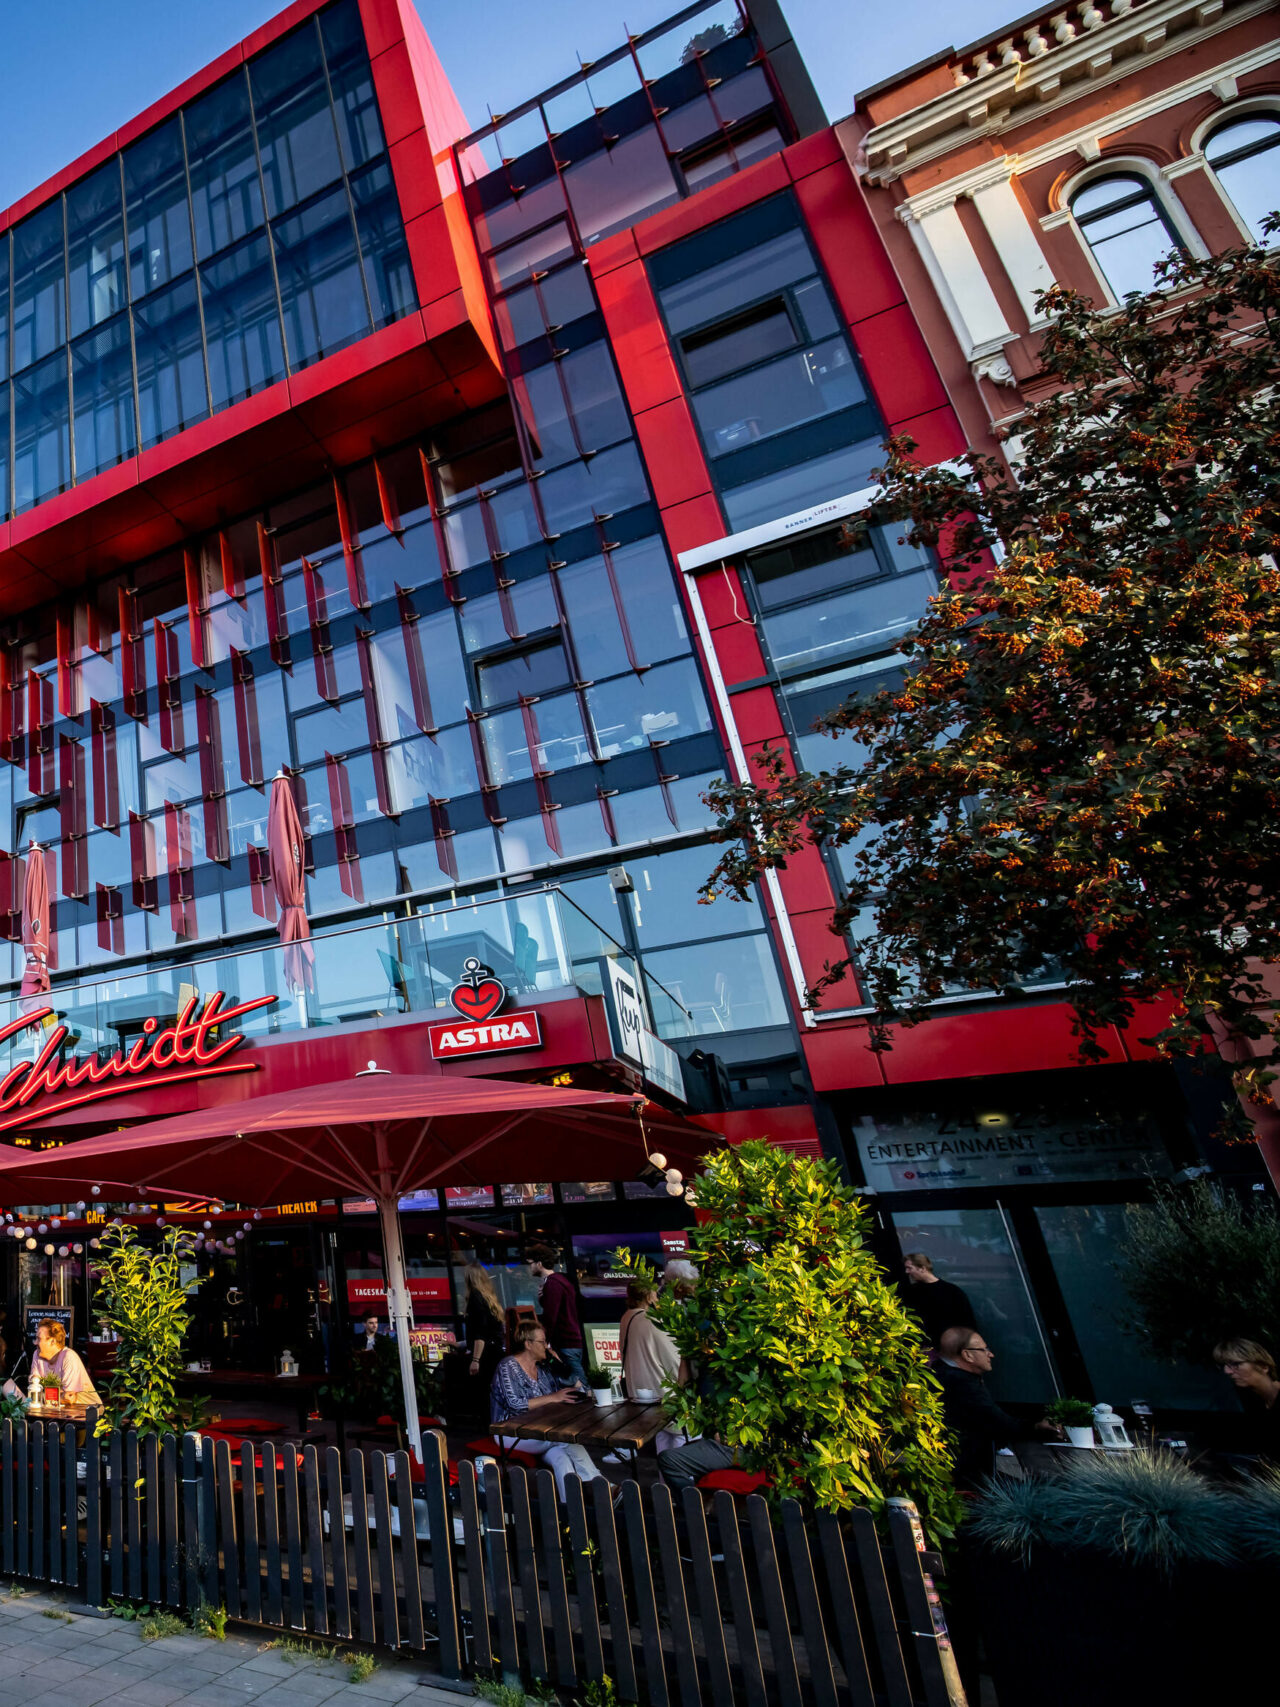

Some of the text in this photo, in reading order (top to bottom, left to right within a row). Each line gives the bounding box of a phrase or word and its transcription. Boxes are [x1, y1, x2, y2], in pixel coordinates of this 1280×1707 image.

[439, 1021, 532, 1050] ASTRA
[867, 1134, 1036, 1160] ENTERTAINMENT
[1060, 1127, 1151, 1148] CENTER
[663, 1239, 686, 1247] Samstag
[355, 1288, 387, 1296] TAGESKA
